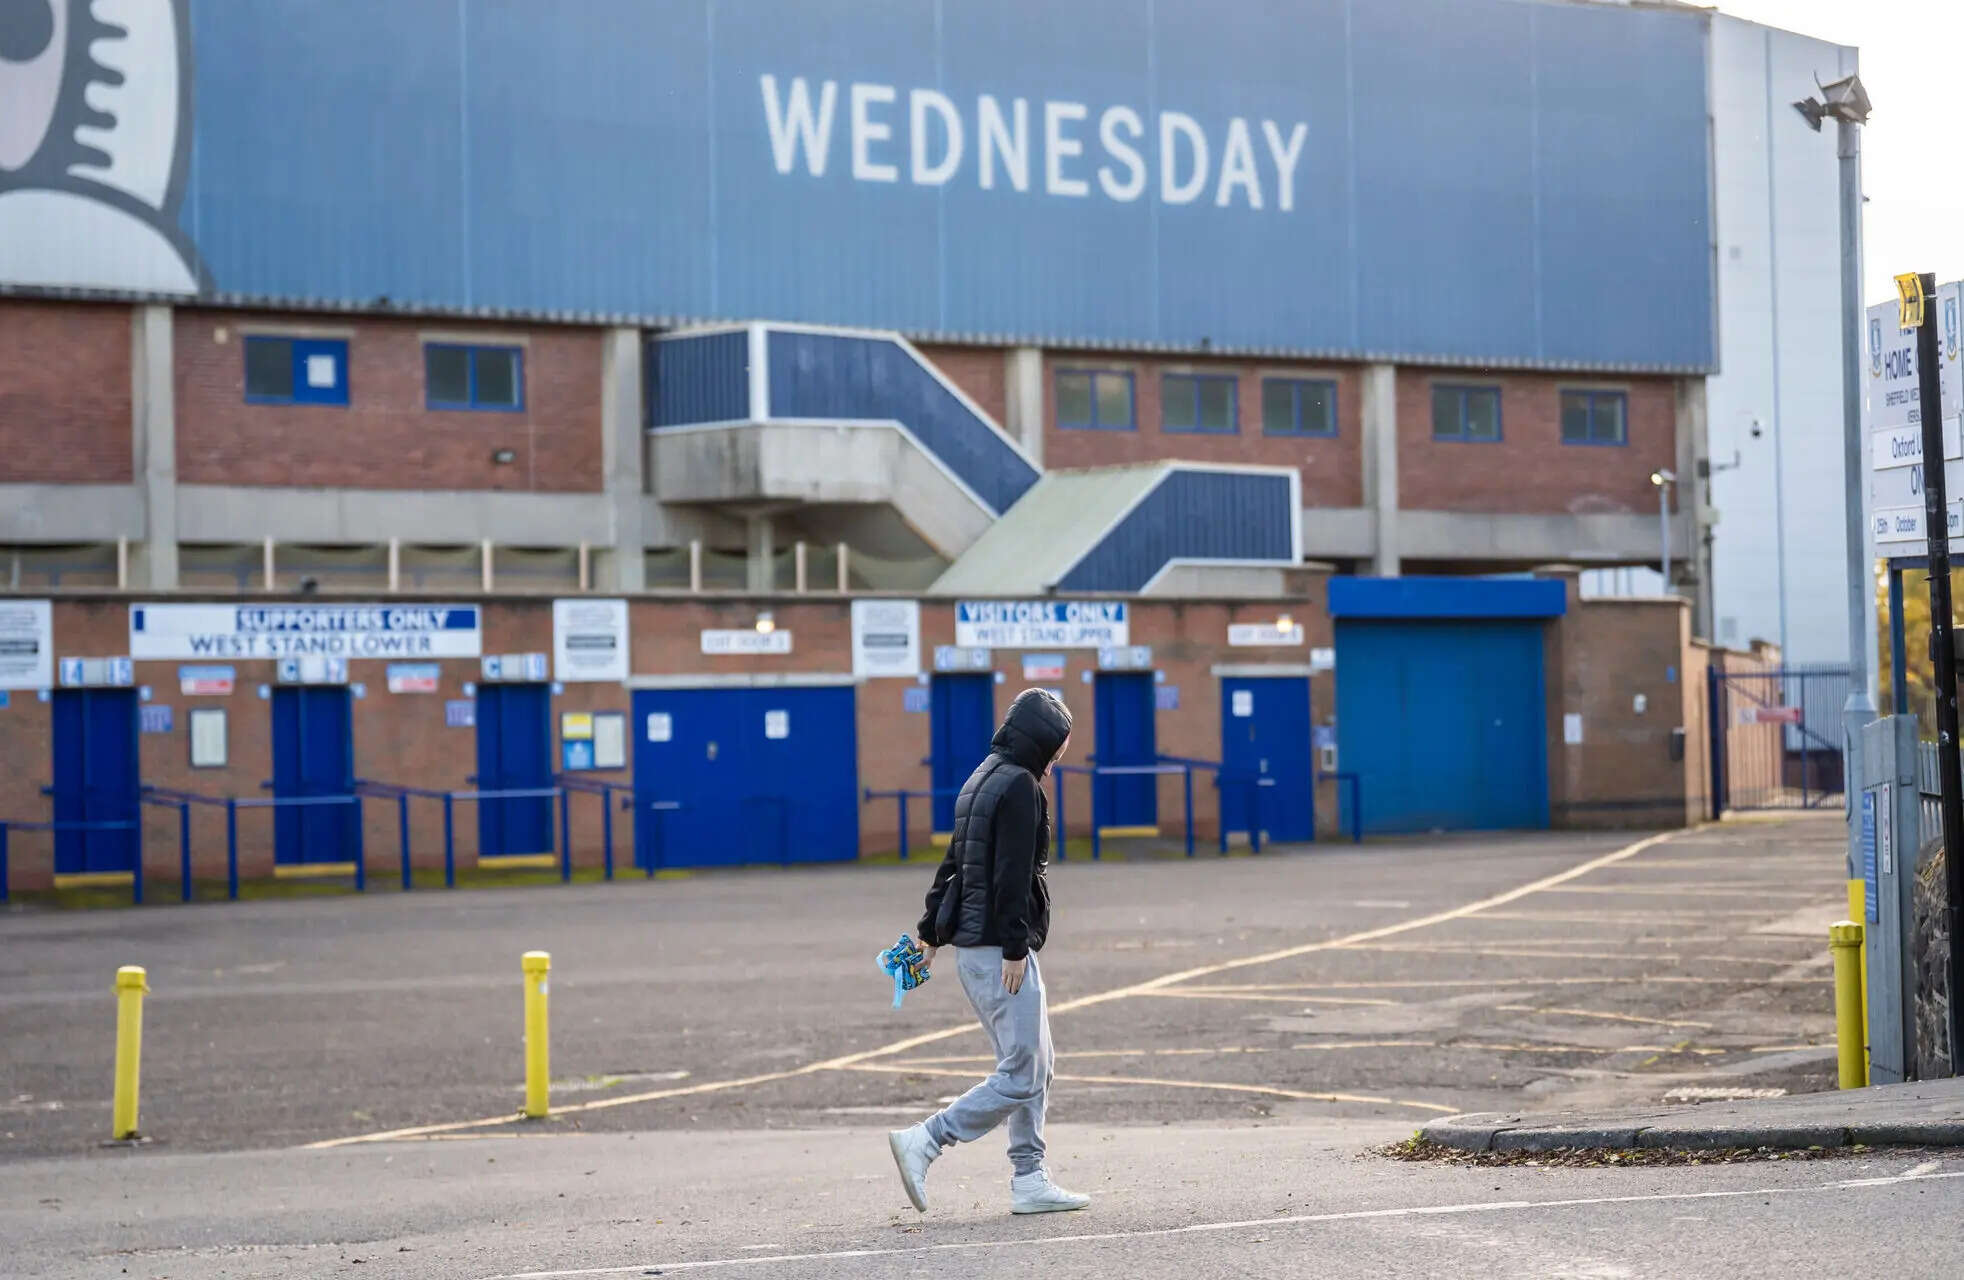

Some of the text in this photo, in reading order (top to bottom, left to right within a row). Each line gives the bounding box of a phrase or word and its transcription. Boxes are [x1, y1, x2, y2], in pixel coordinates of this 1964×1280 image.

[760, 73, 1308, 212] WEDNESDAY
[1885, 347, 1912, 380] HOME
[1892, 433, 1915, 459] Oxford
[240, 608, 449, 632] SUPPORTERS ONLY
[967, 601, 1119, 622] VISITORS ONLY
[190, 634, 432, 652] WEST STAND LOWER
[977, 626, 1112, 642] WEST STAND UPPER
